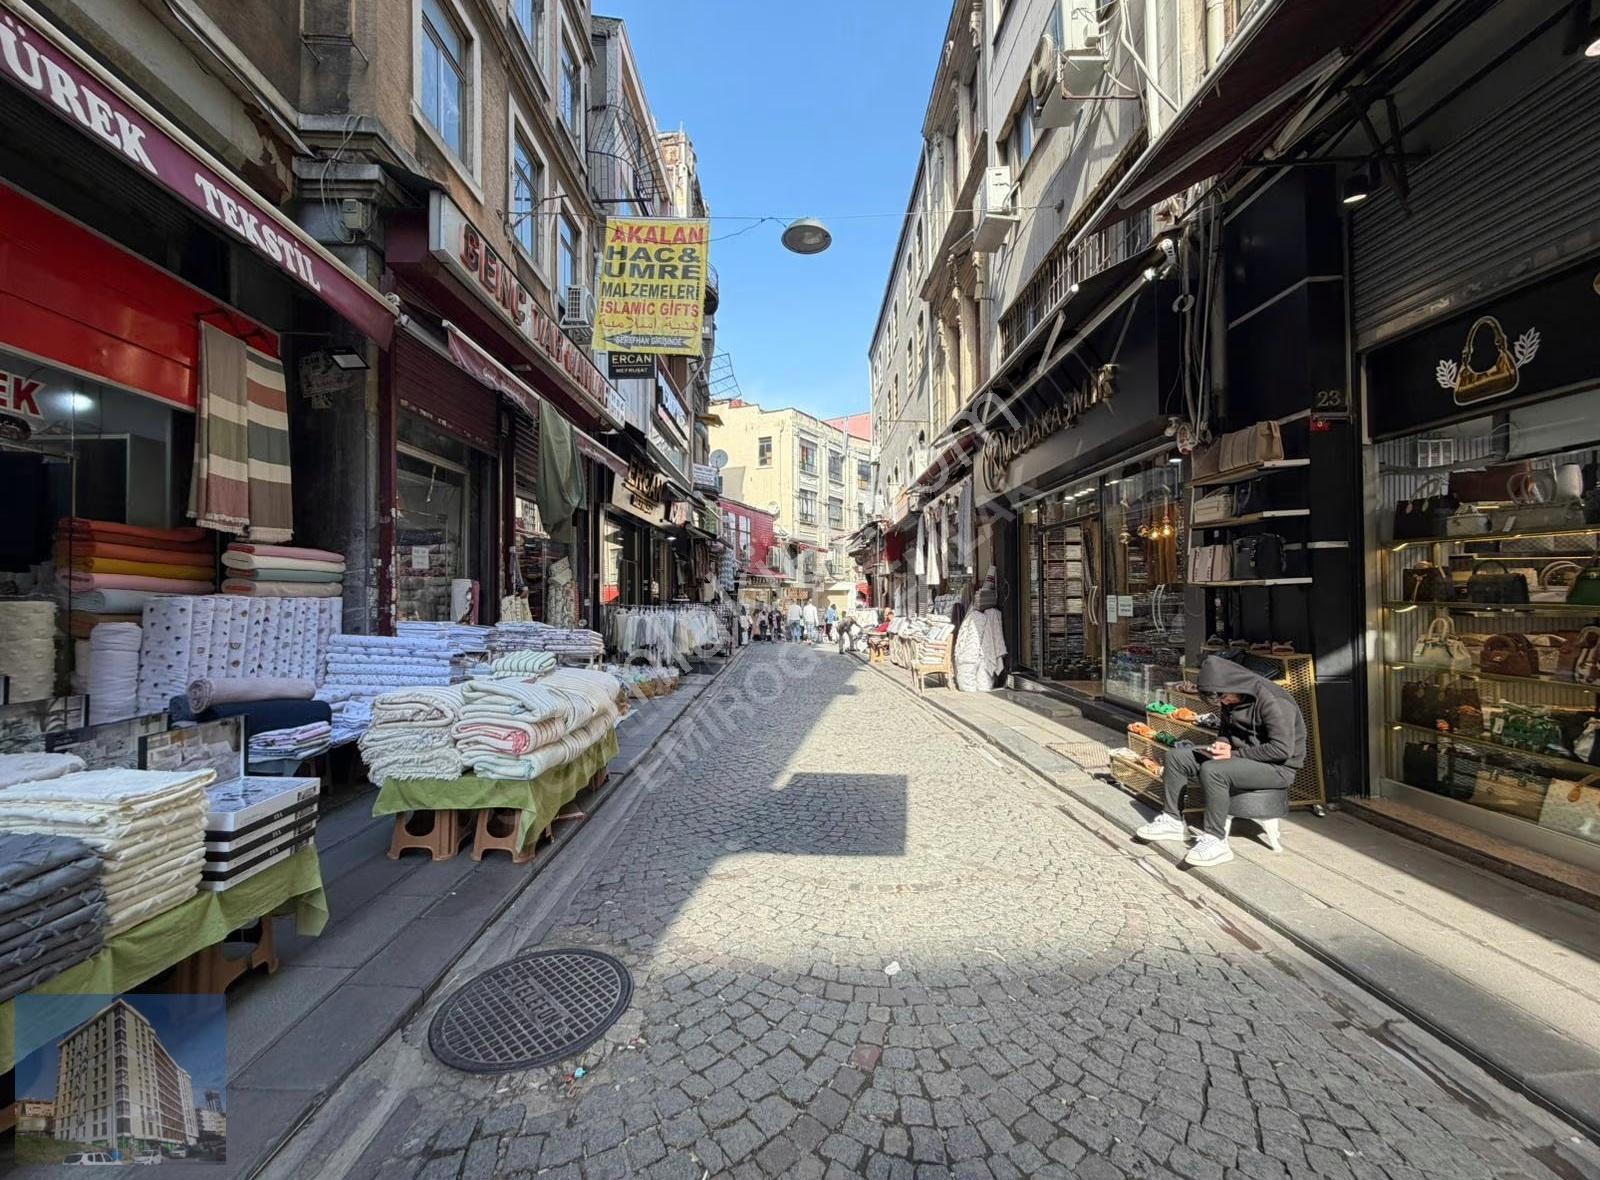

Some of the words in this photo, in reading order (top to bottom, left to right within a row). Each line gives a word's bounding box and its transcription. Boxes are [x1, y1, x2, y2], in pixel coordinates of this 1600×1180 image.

[194, 173, 321, 292] TEKSTİL
[611, 224, 704, 245] AKALAN
[459, 222, 527, 327] GENÇ
[604, 261, 701, 280] UMRE
[601, 280, 700, 301] MALZEMELERİ
[611, 353, 653, 365] ERCAN
[1316, 389, 1341, 408] 23
